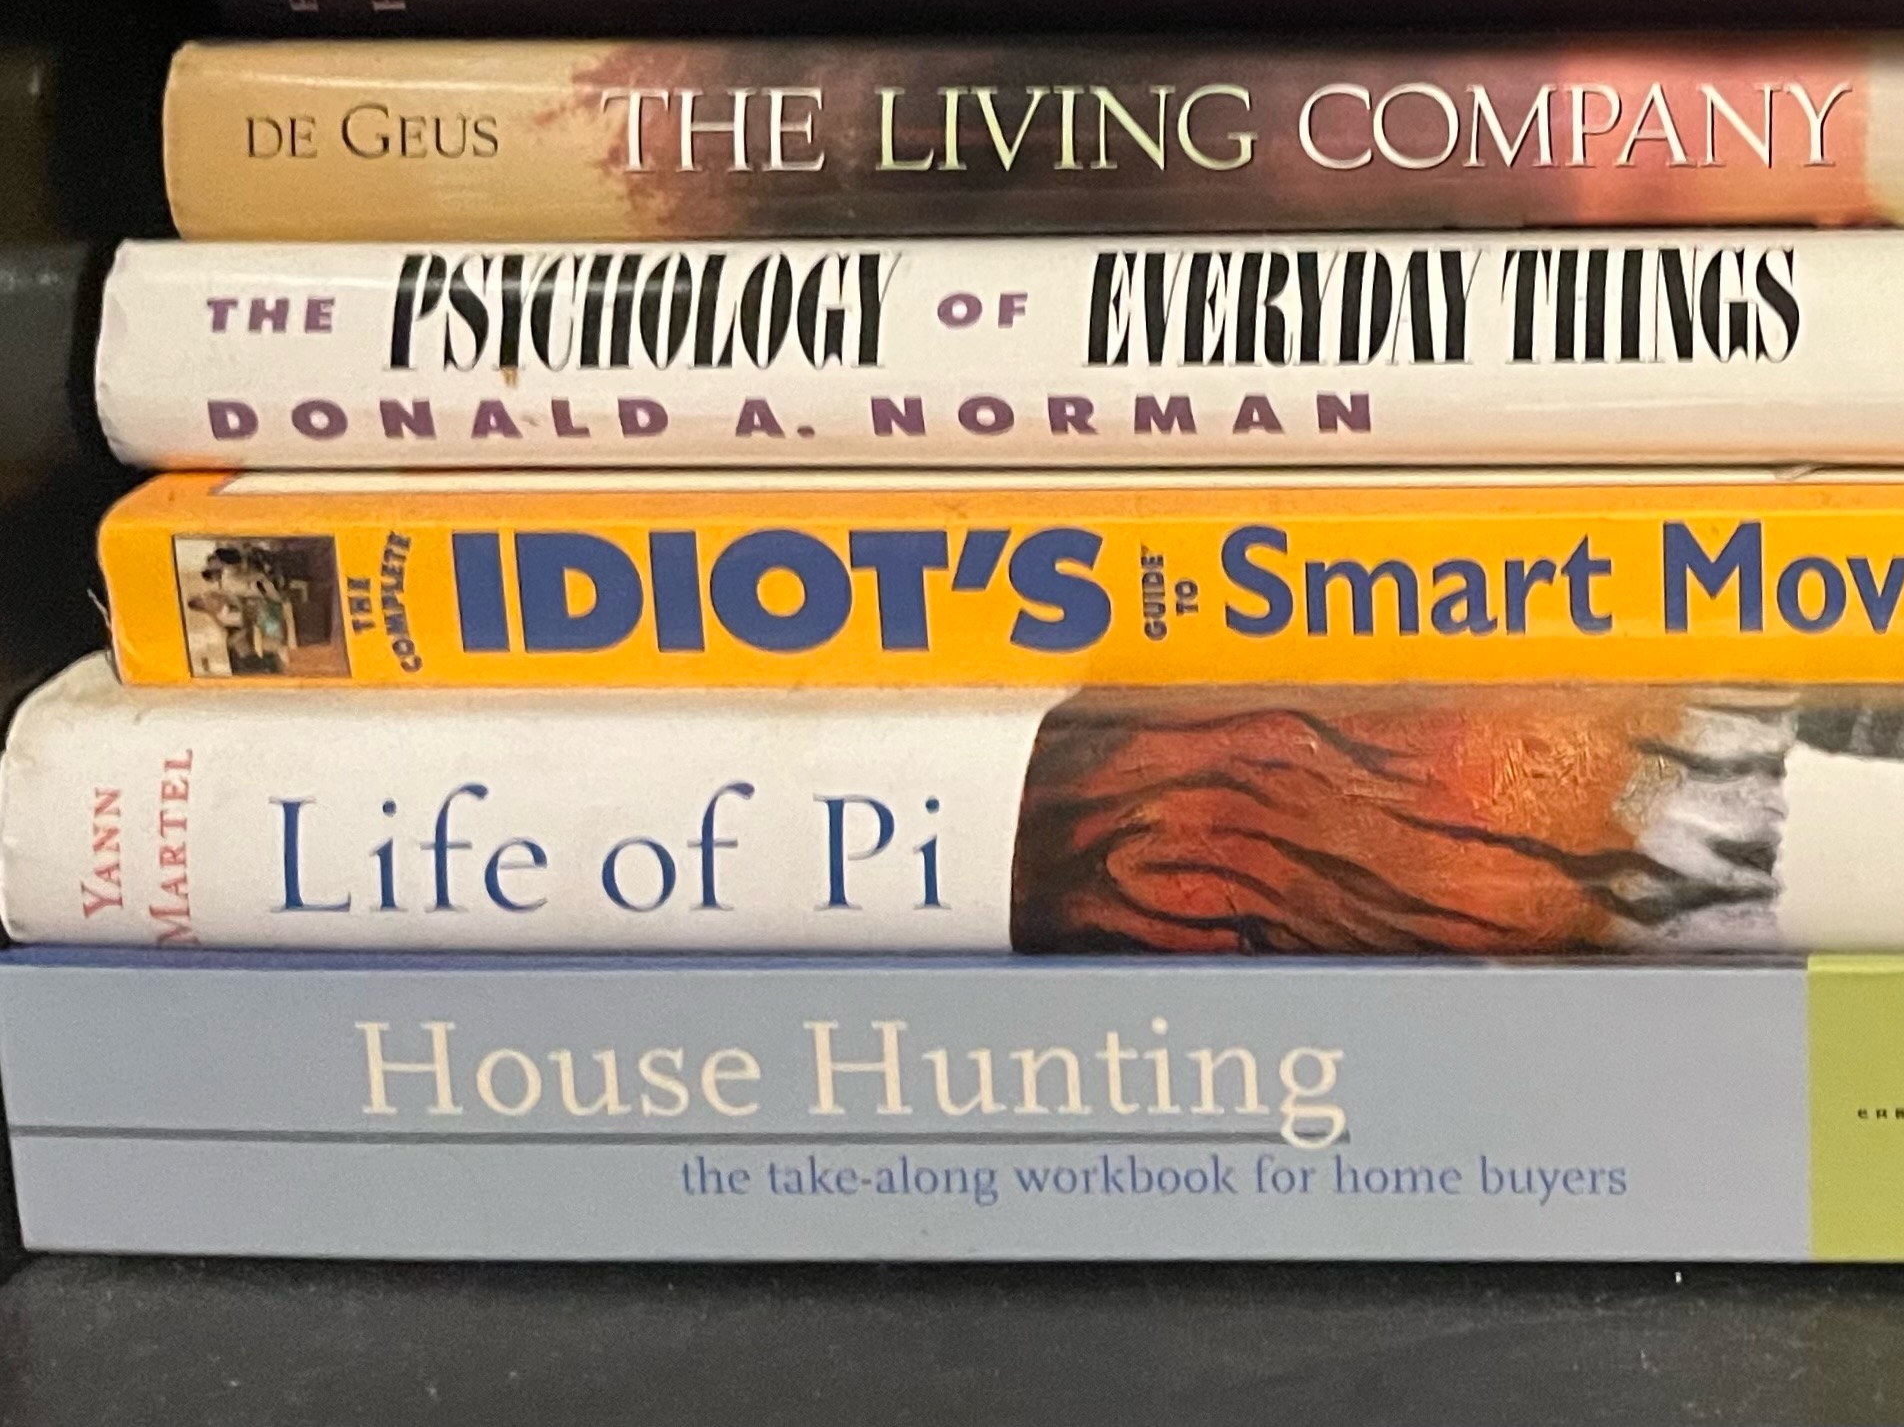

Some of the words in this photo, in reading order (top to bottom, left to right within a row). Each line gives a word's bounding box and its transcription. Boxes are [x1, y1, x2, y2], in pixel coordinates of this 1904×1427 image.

[605, 86, 824, 172] THE
[877, 84, 1257, 172] LIVING
[1297, 79, 1853, 172] COMPANY
[206, 298, 336, 335] THE
[386, 251, 903, 374] PSYCHOLOGY
[936, 293, 1030, 328] OF
[1083, 246, 1484, 370] EVERYDAY
[1500, 245, 1800, 367] THINGS
[208, 397, 668, 440] DONALD
[736, 396, 815, 438] A.
[873, 392, 1371, 437] NORMAN
[347, 576, 376, 635] THE
[380, 530, 422, 672] COMPLETE
[451, 528, 1113, 654] IDIOT'S
[1175, 579, 1199, 616] TO
[1222, 523, 1614, 638] Smart
[81, 787, 124, 918] YANN
[149, 748, 200, 948] MARTEL
[268, 782, 548, 916] Life
[600, 782, 754, 912] of
[811, 792, 953, 912] Pi
[354, 1018, 762, 1117] House
[804, 1015, 1345, 1148] Hunting
[682, 1155, 751, 1199] the
[766, 1155, 998, 1207] take-along
[1015, 1155, 1237, 1199] workbook
[1255, 1155, 1322, 1197] for
[1333, 1156, 1466, 1198] home
[1479, 1156, 1629, 1206] buyers
